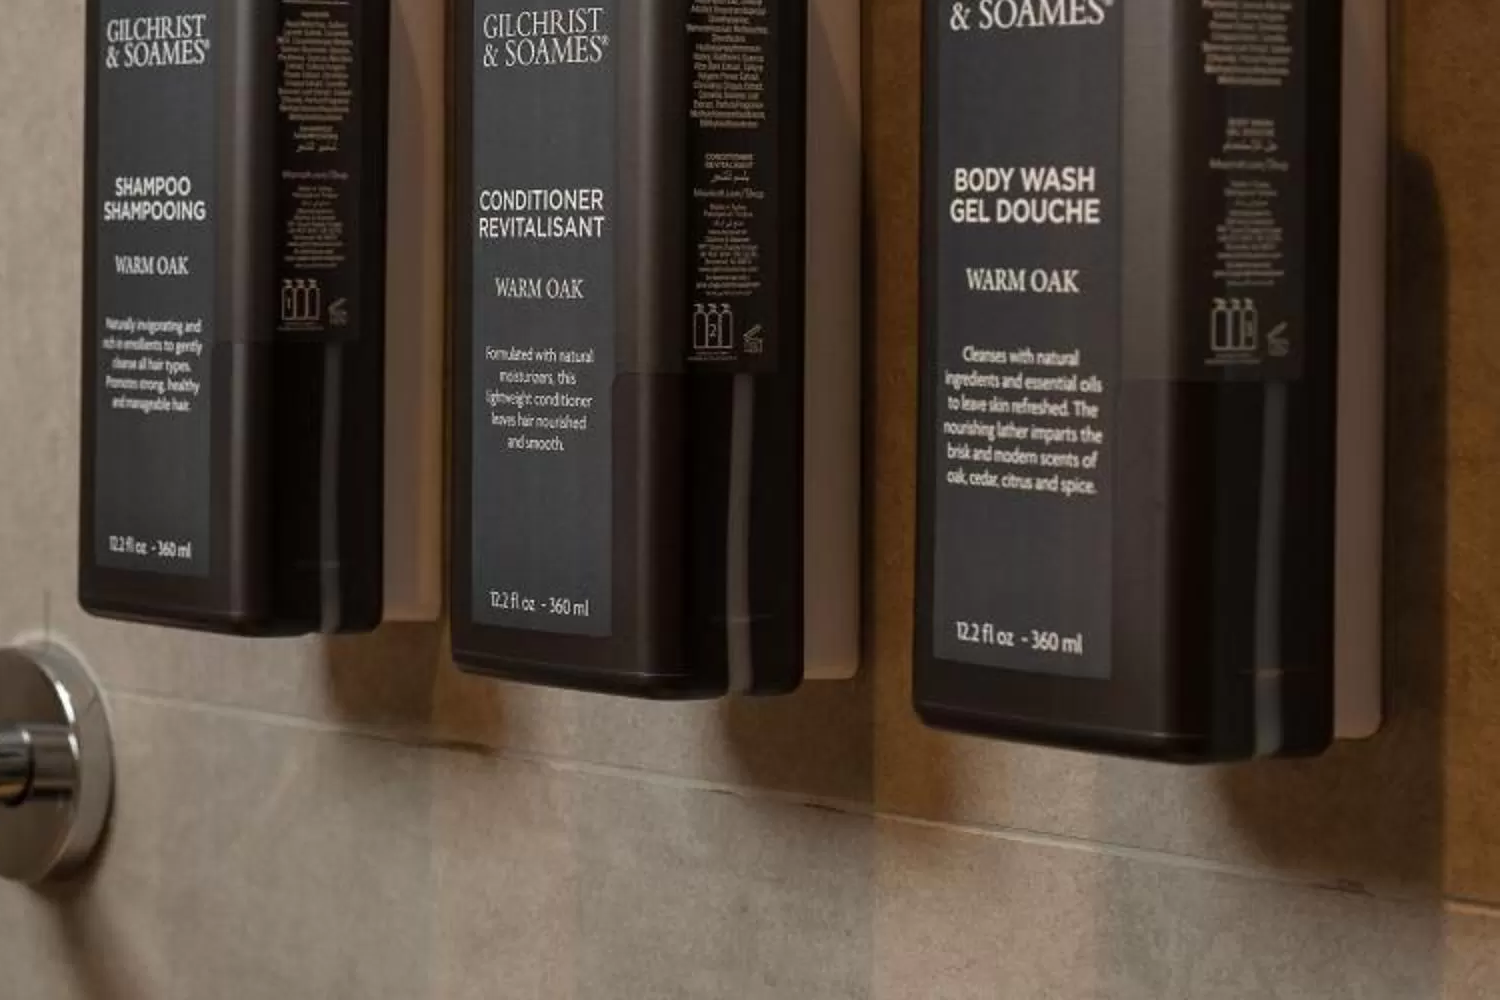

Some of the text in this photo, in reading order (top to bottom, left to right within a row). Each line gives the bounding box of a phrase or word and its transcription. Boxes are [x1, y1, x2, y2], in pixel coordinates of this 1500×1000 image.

[483, 7, 604, 39] GILCHRIST
[950, 2, 970, 31] &
[106, 14, 207, 43] GILCHRIST
[105, 45, 120, 69] &
[483, 43, 499, 68] &
[115, 176, 192, 197] SHAMPOO
[955, 166, 1096, 192] BODY WASH
[103, 200, 207, 221] SHAMPOOING
[479, 188, 604, 211] CONDITIONER
[950, 198, 1100, 224] GEL DOUCHE
[479, 215, 605, 238] REVITALISANT
[115, 255, 189, 276] WARM OAK
[495, 276, 584, 299] WARM OAK
[966, 267, 1080, 294] WARM OAK
[185, 317, 202, 333] and
[163, 340, 175, 352] to
[175, 339, 203, 357] gently
[485, 345, 595, 363] Formulated with natural
[962, 345, 1080, 367] Cleanses with natural
[167, 377, 200, 397] healthy
[557, 369, 577, 385] this
[944, 369, 1103, 393] ingredients and essential oils
[533, 392, 593, 407] conditioner
[948, 396, 960, 411] to
[961, 394, 987, 412] leave
[989, 396, 1010, 413] skin
[1072, 400, 1099, 419] The
[517, 411, 535, 427] hair
[535, 414, 587, 430] nourished
[943, 419, 1103, 446] nourishing lather imparts the
[947, 442, 1098, 469] brisk and modern scents of
[1001, 473, 1033, 490] citrus
[1034, 474, 1059, 492] and
[157, 540, 176, 557] 360
[178, 541, 191, 558] ml
[510, 591, 519, 609] fl
[549, 596, 571, 615] 360
[573, 599, 589, 617] ml
[982, 622, 994, 645] fl
[1031, 629, 1059, 652] 360
[1061, 633, 1083, 656] ml
